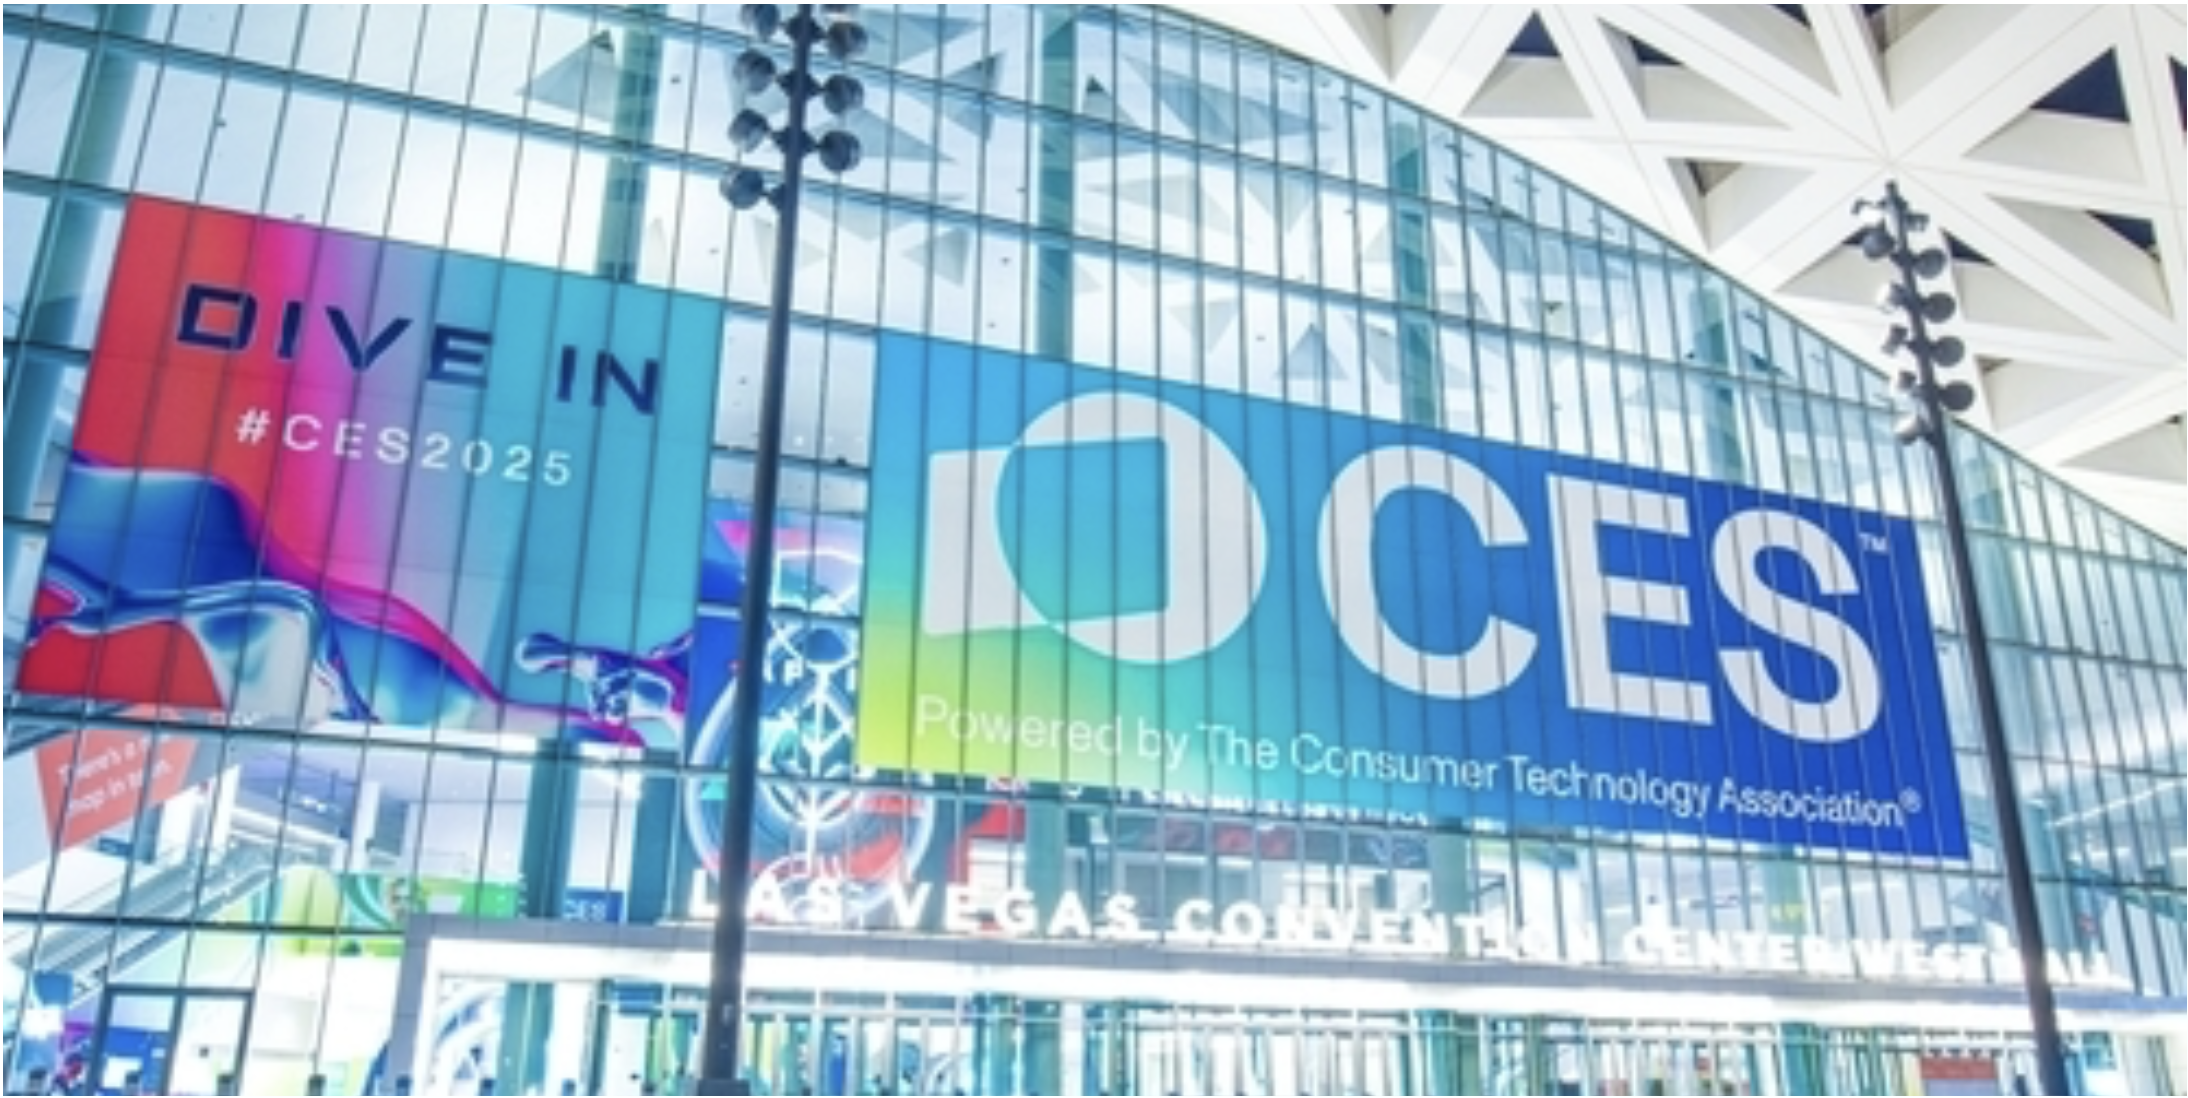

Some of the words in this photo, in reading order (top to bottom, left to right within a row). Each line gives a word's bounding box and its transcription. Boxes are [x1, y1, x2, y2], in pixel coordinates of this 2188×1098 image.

[176, 282, 493, 389] DIVE
[555, 345, 661, 417] IN
[235, 407, 572, 487] #CES2025
[914, 693, 1121, 757] Powered
[1136, 714, 1188, 772] by
[1197, 724, 1279, 770] The
[1290, 732, 1497, 789] Consumer
[1507, 754, 1712, 819] Technology
[687, 868, 844, 926] LAS
[887, 878, 1142, 937] VEGAS
[1172, 898, 1600, 965] CONVENTION
[1623, 926, 1852, 974] CENTER
[1854, 939, 1985, 980] WEST
